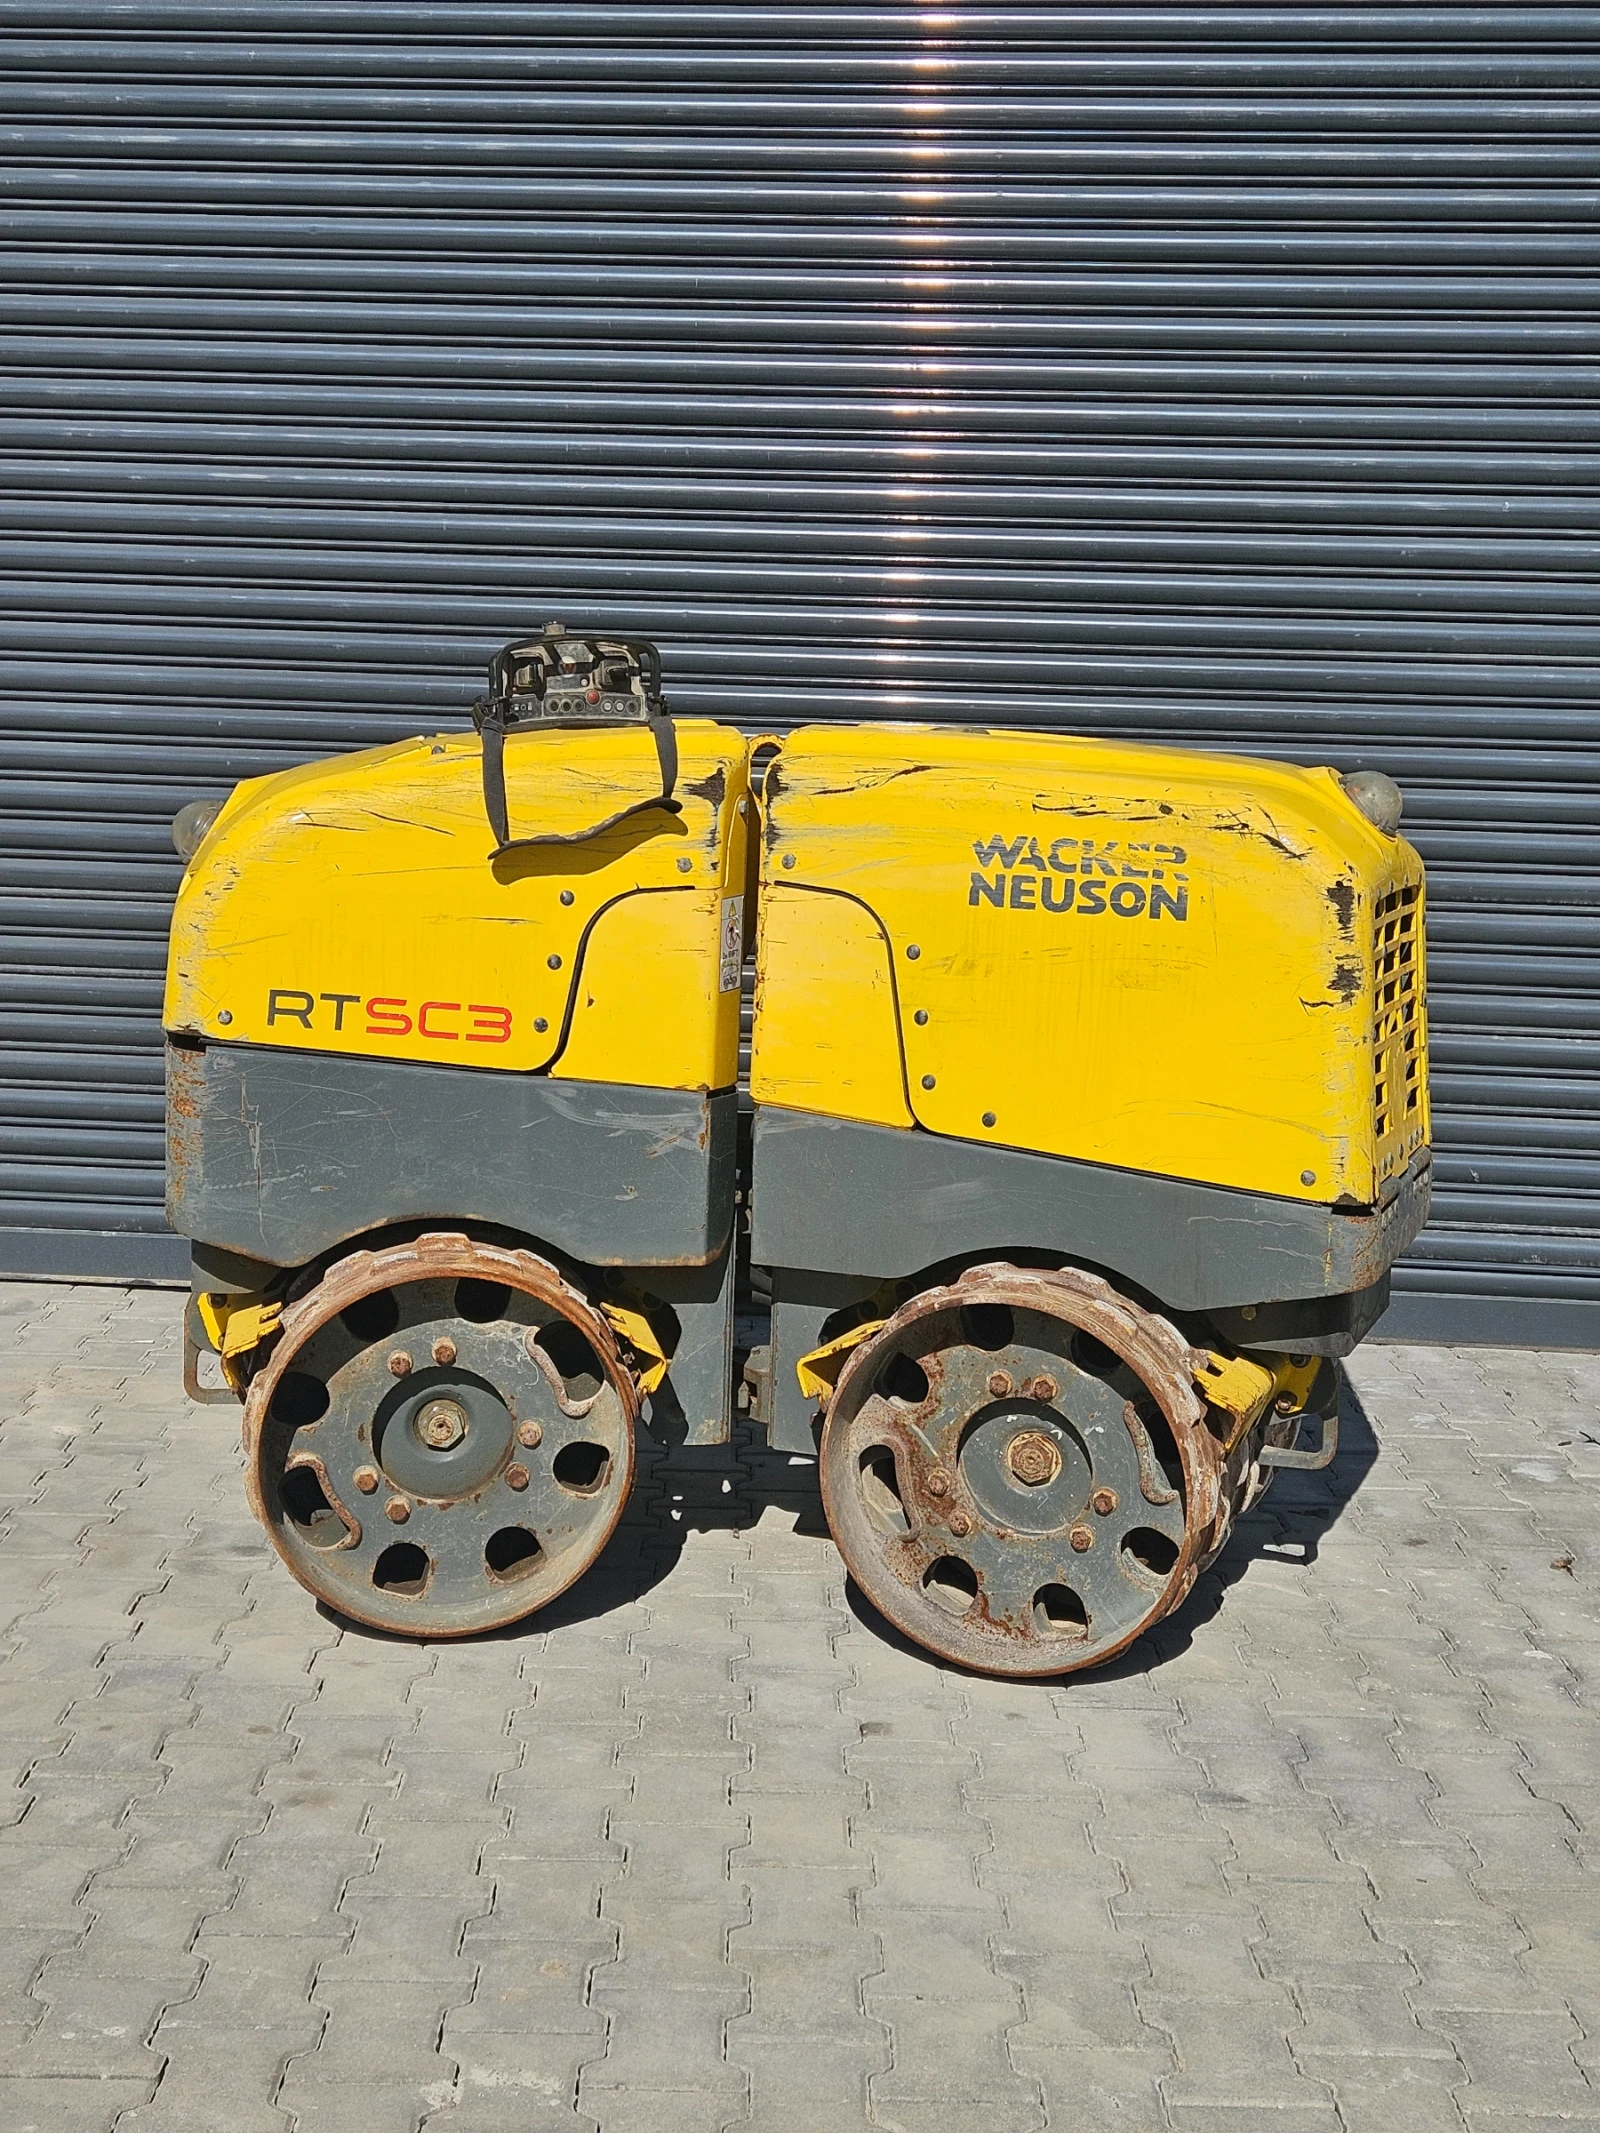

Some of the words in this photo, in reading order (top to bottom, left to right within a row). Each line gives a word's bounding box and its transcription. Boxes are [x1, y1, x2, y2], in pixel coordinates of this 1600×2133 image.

[971, 834, 1189, 881] WACKER
[968, 872, 1189, 921] NEUSON
[266, 989, 513, 1043] RTSC3
